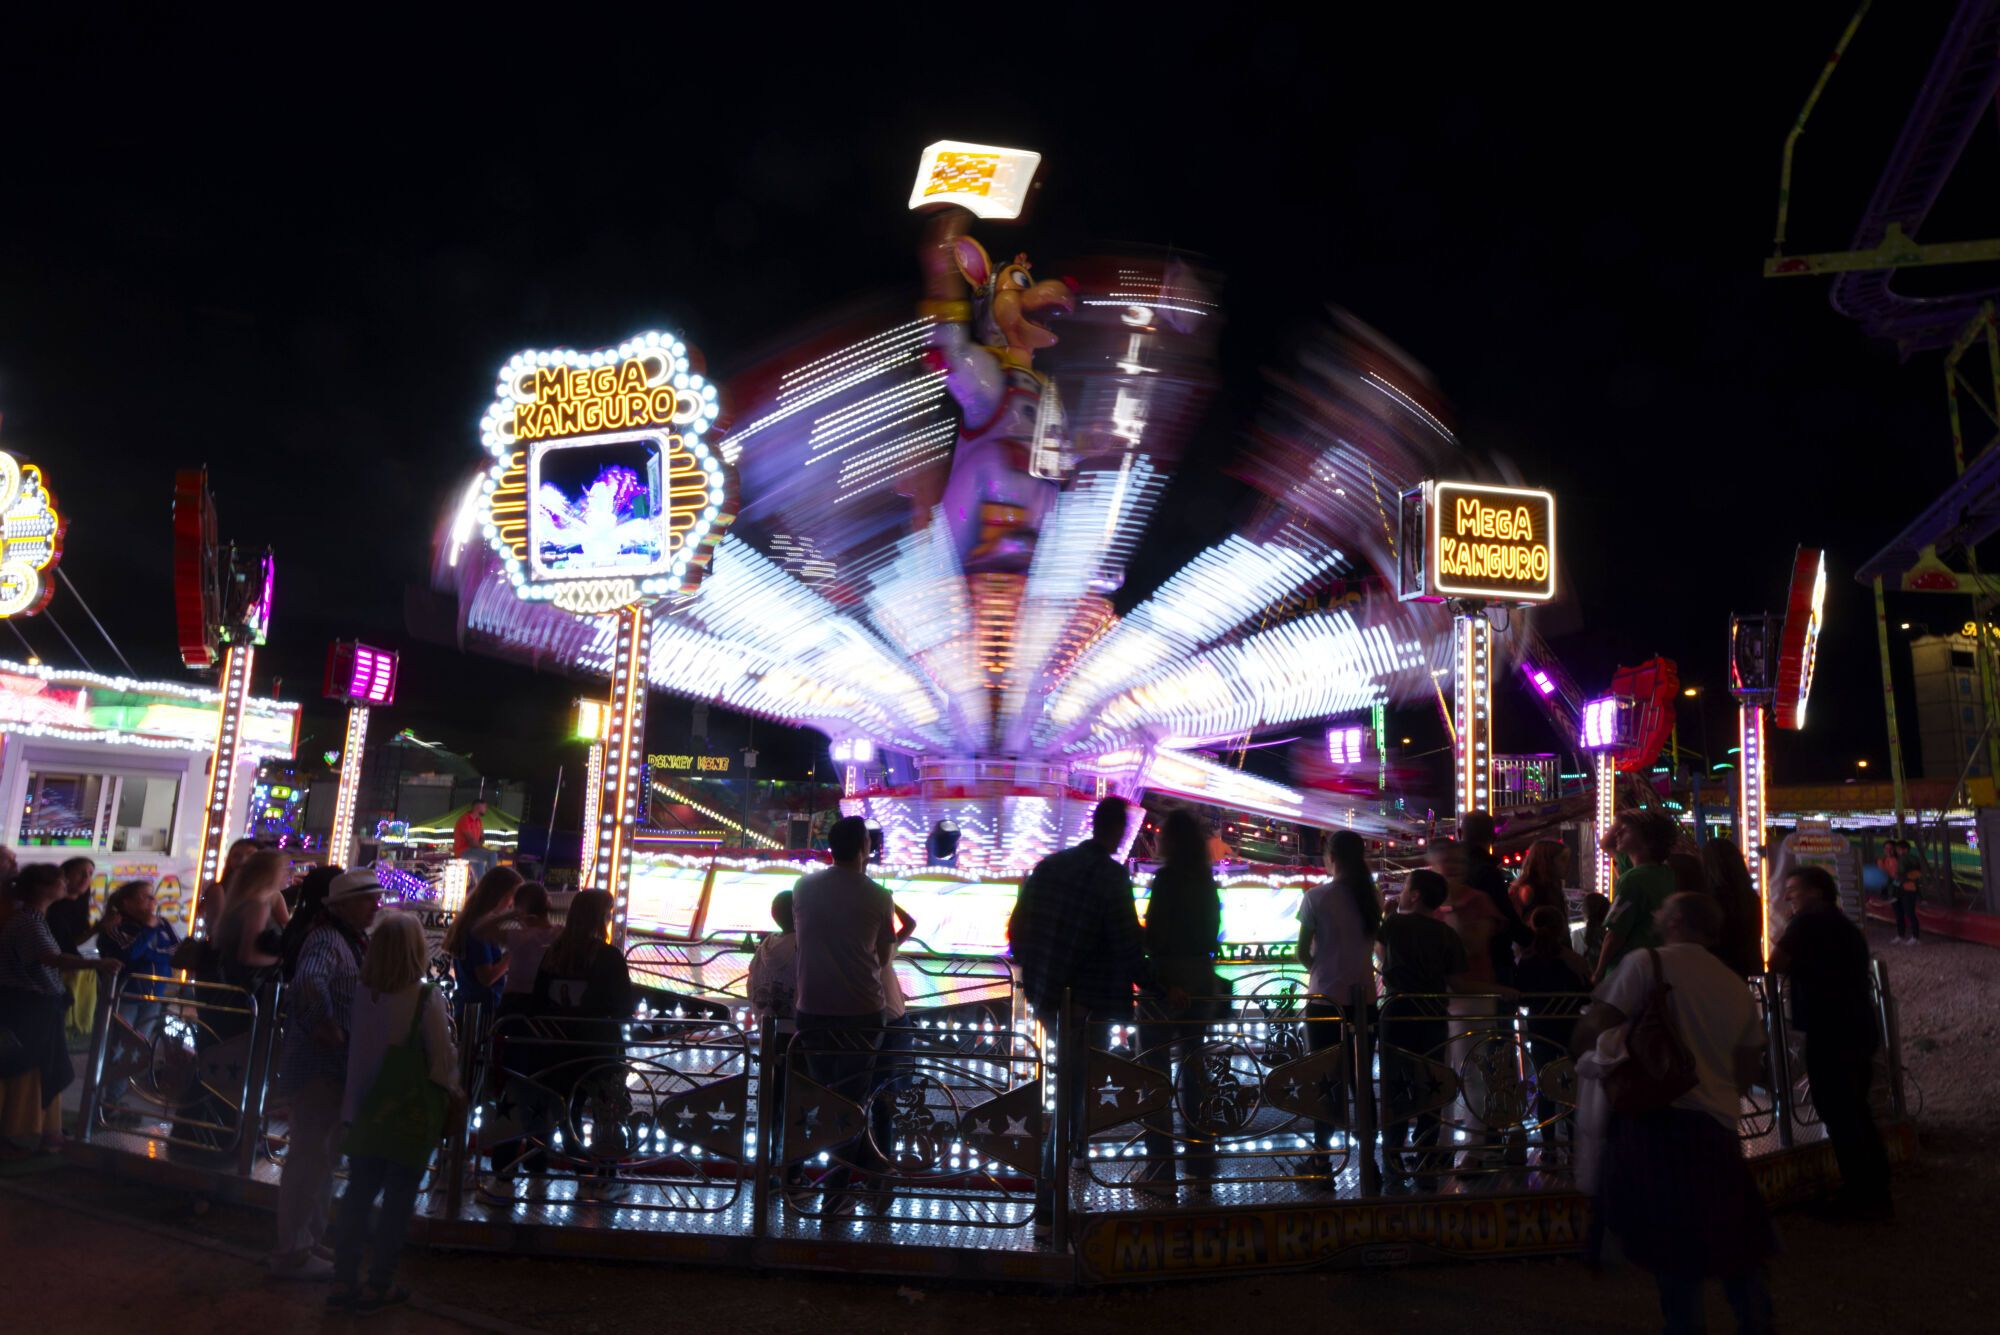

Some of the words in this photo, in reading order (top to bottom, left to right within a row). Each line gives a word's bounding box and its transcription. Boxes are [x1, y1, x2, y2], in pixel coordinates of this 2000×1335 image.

[535, 357, 648, 405] MEGA
[513, 385, 677, 439] KANGURO
[1456, 497, 1533, 541] MEGA
[1440, 536, 1548, 582] KANGURO
[647, 754, 694, 770] DONKEY
[1215, 943, 1296, 960] ATRACC
[1112, 1215, 1259, 1274] MEGA
[1277, 1203, 1498, 1261] KANGURO
